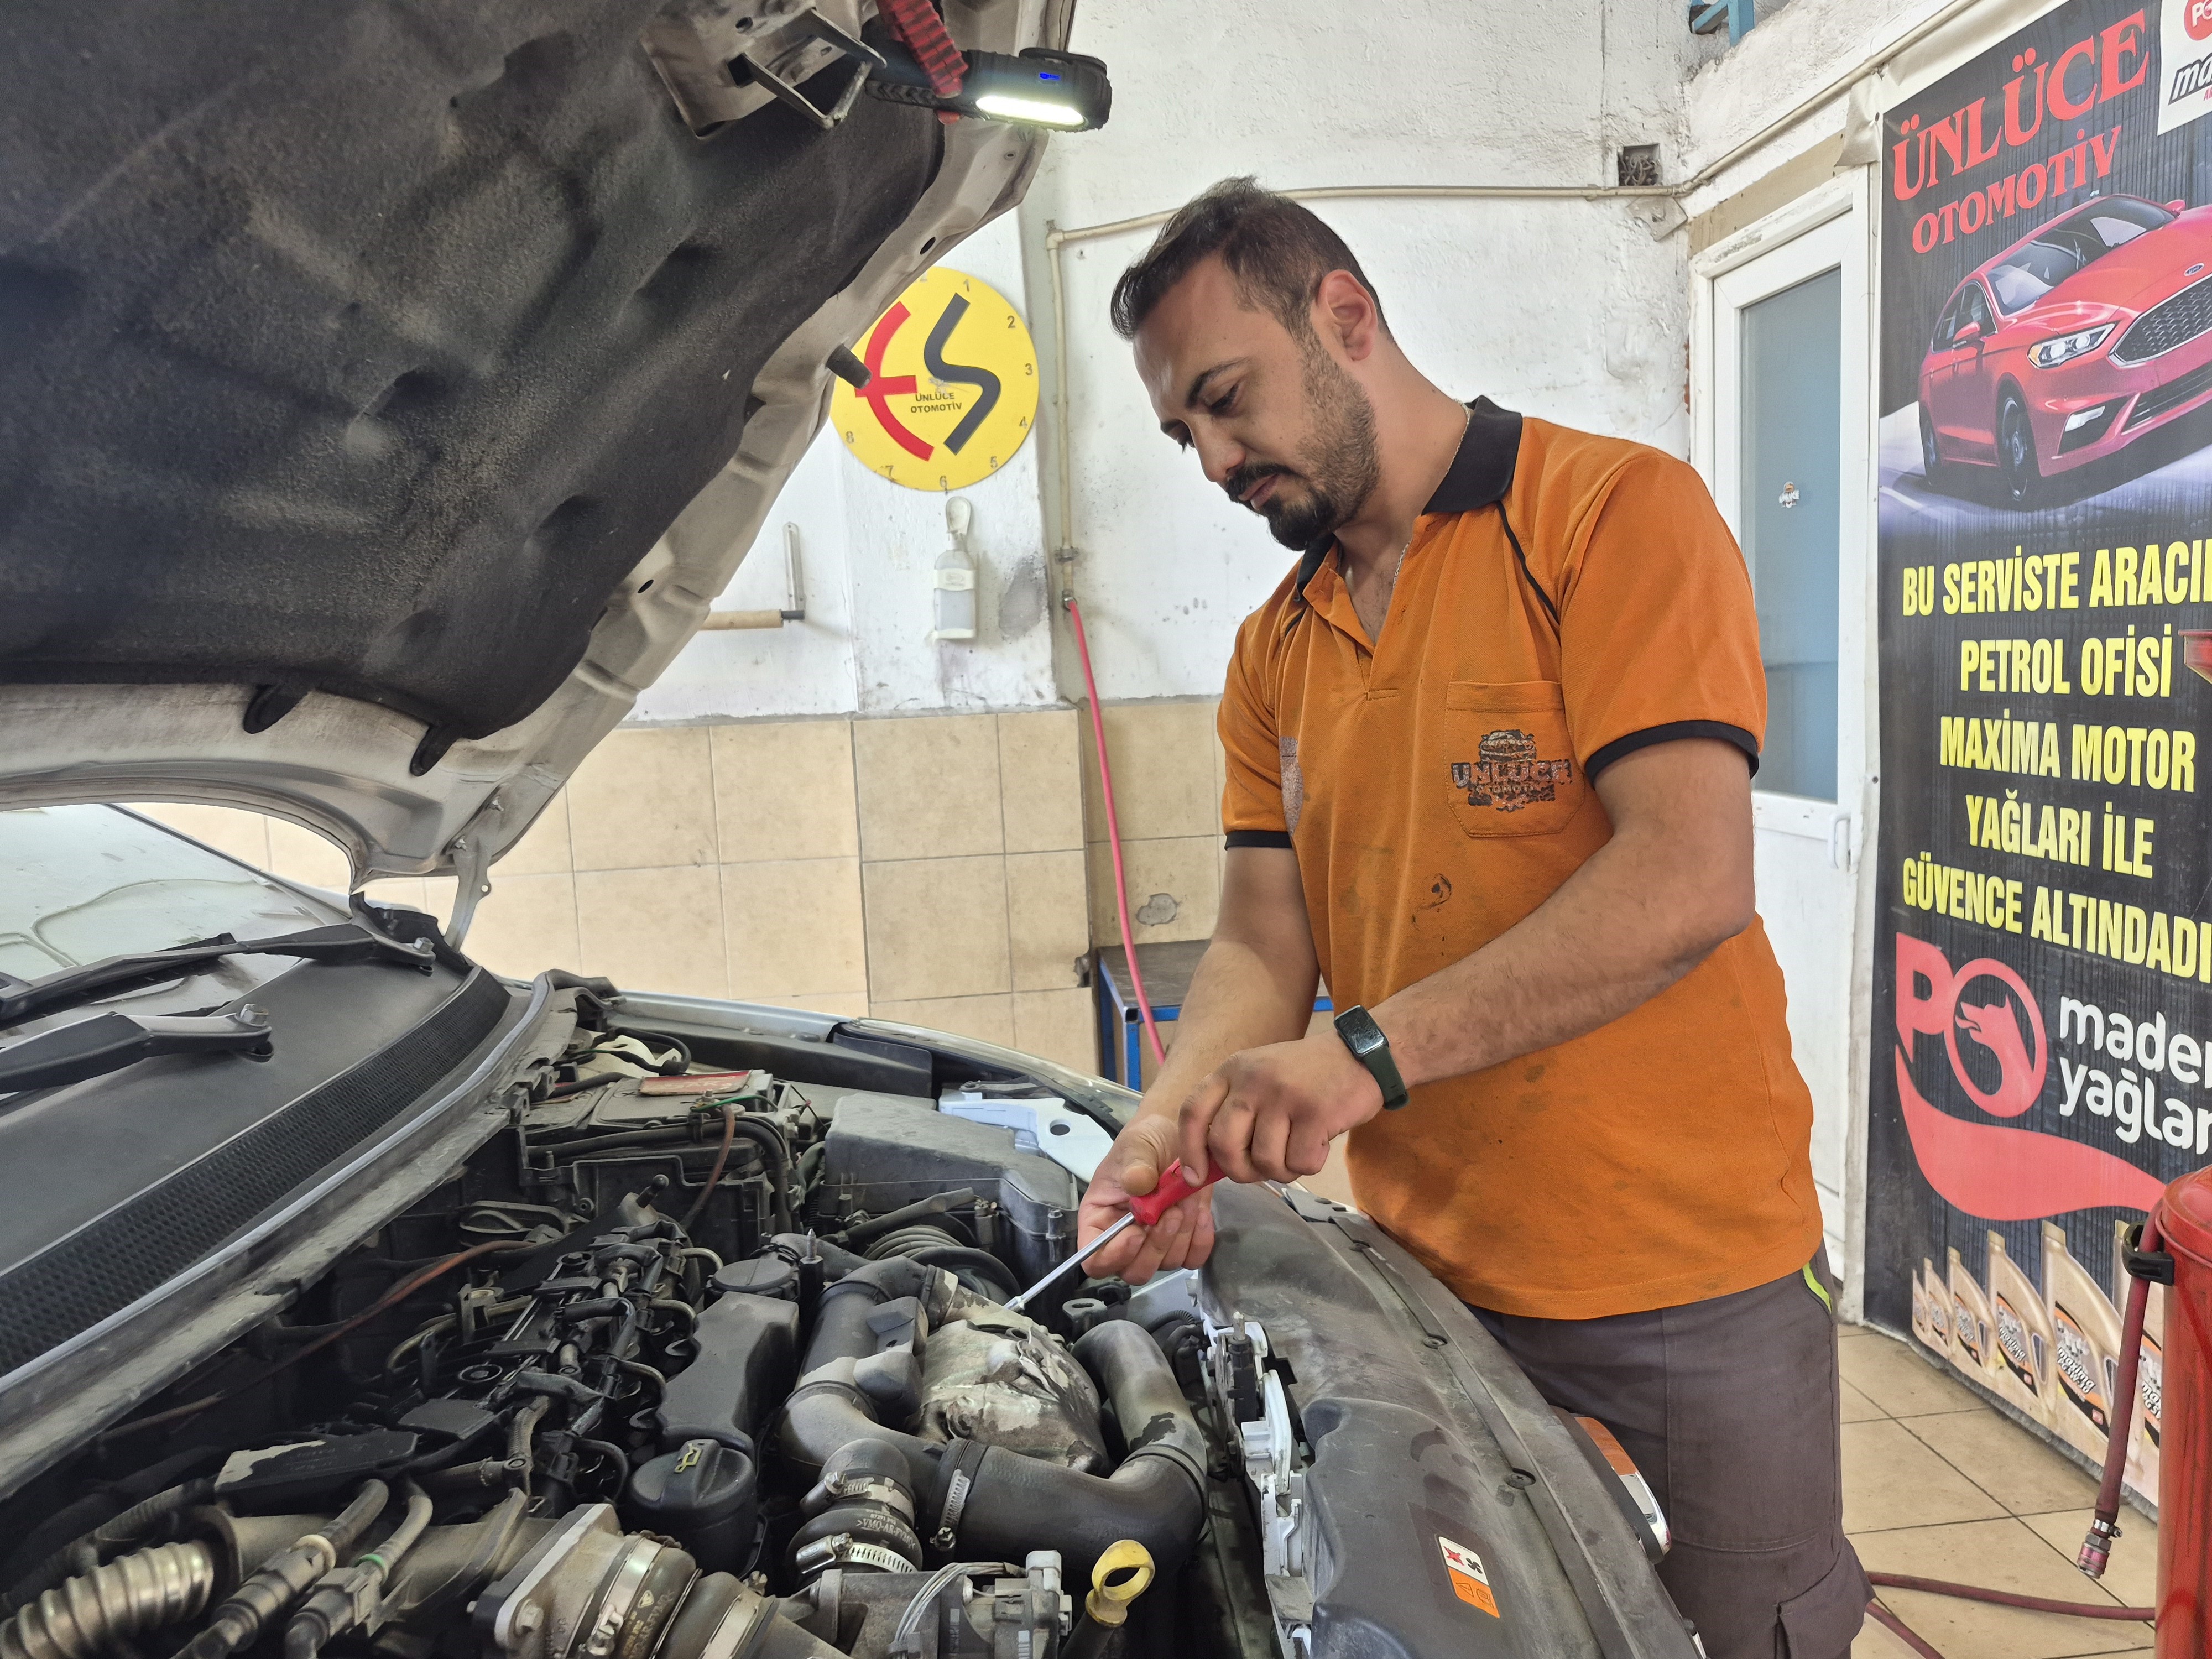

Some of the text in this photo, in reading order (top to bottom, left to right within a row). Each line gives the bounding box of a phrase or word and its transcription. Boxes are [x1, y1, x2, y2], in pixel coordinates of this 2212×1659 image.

[1892, 9, 2150, 201] ÜNLÜCE
[1912, 126, 2121, 254] OTOMOTİV
[1006, 315, 1016, 328] 2
[1025, 363, 1033, 376] 3
[846, 431, 854, 444] 8
[1019, 416, 1027, 429] 4
[940, 475, 947, 489] 6
[990, 456, 998, 469] 5
[1903, 565, 1934, 617] BU
[1943, 545, 2080, 615] SERVİSTE
[1961, 623, 2172, 698] PETROL OFİSİ
[1940, 708, 2196, 793] MAXİMA MOTOR
[1965, 788, 2154, 879] YAĞLARI İLE
[1903, 851, 2023, 935] GÜVENCE
[2057, 1347, 2096, 1389] maxima
